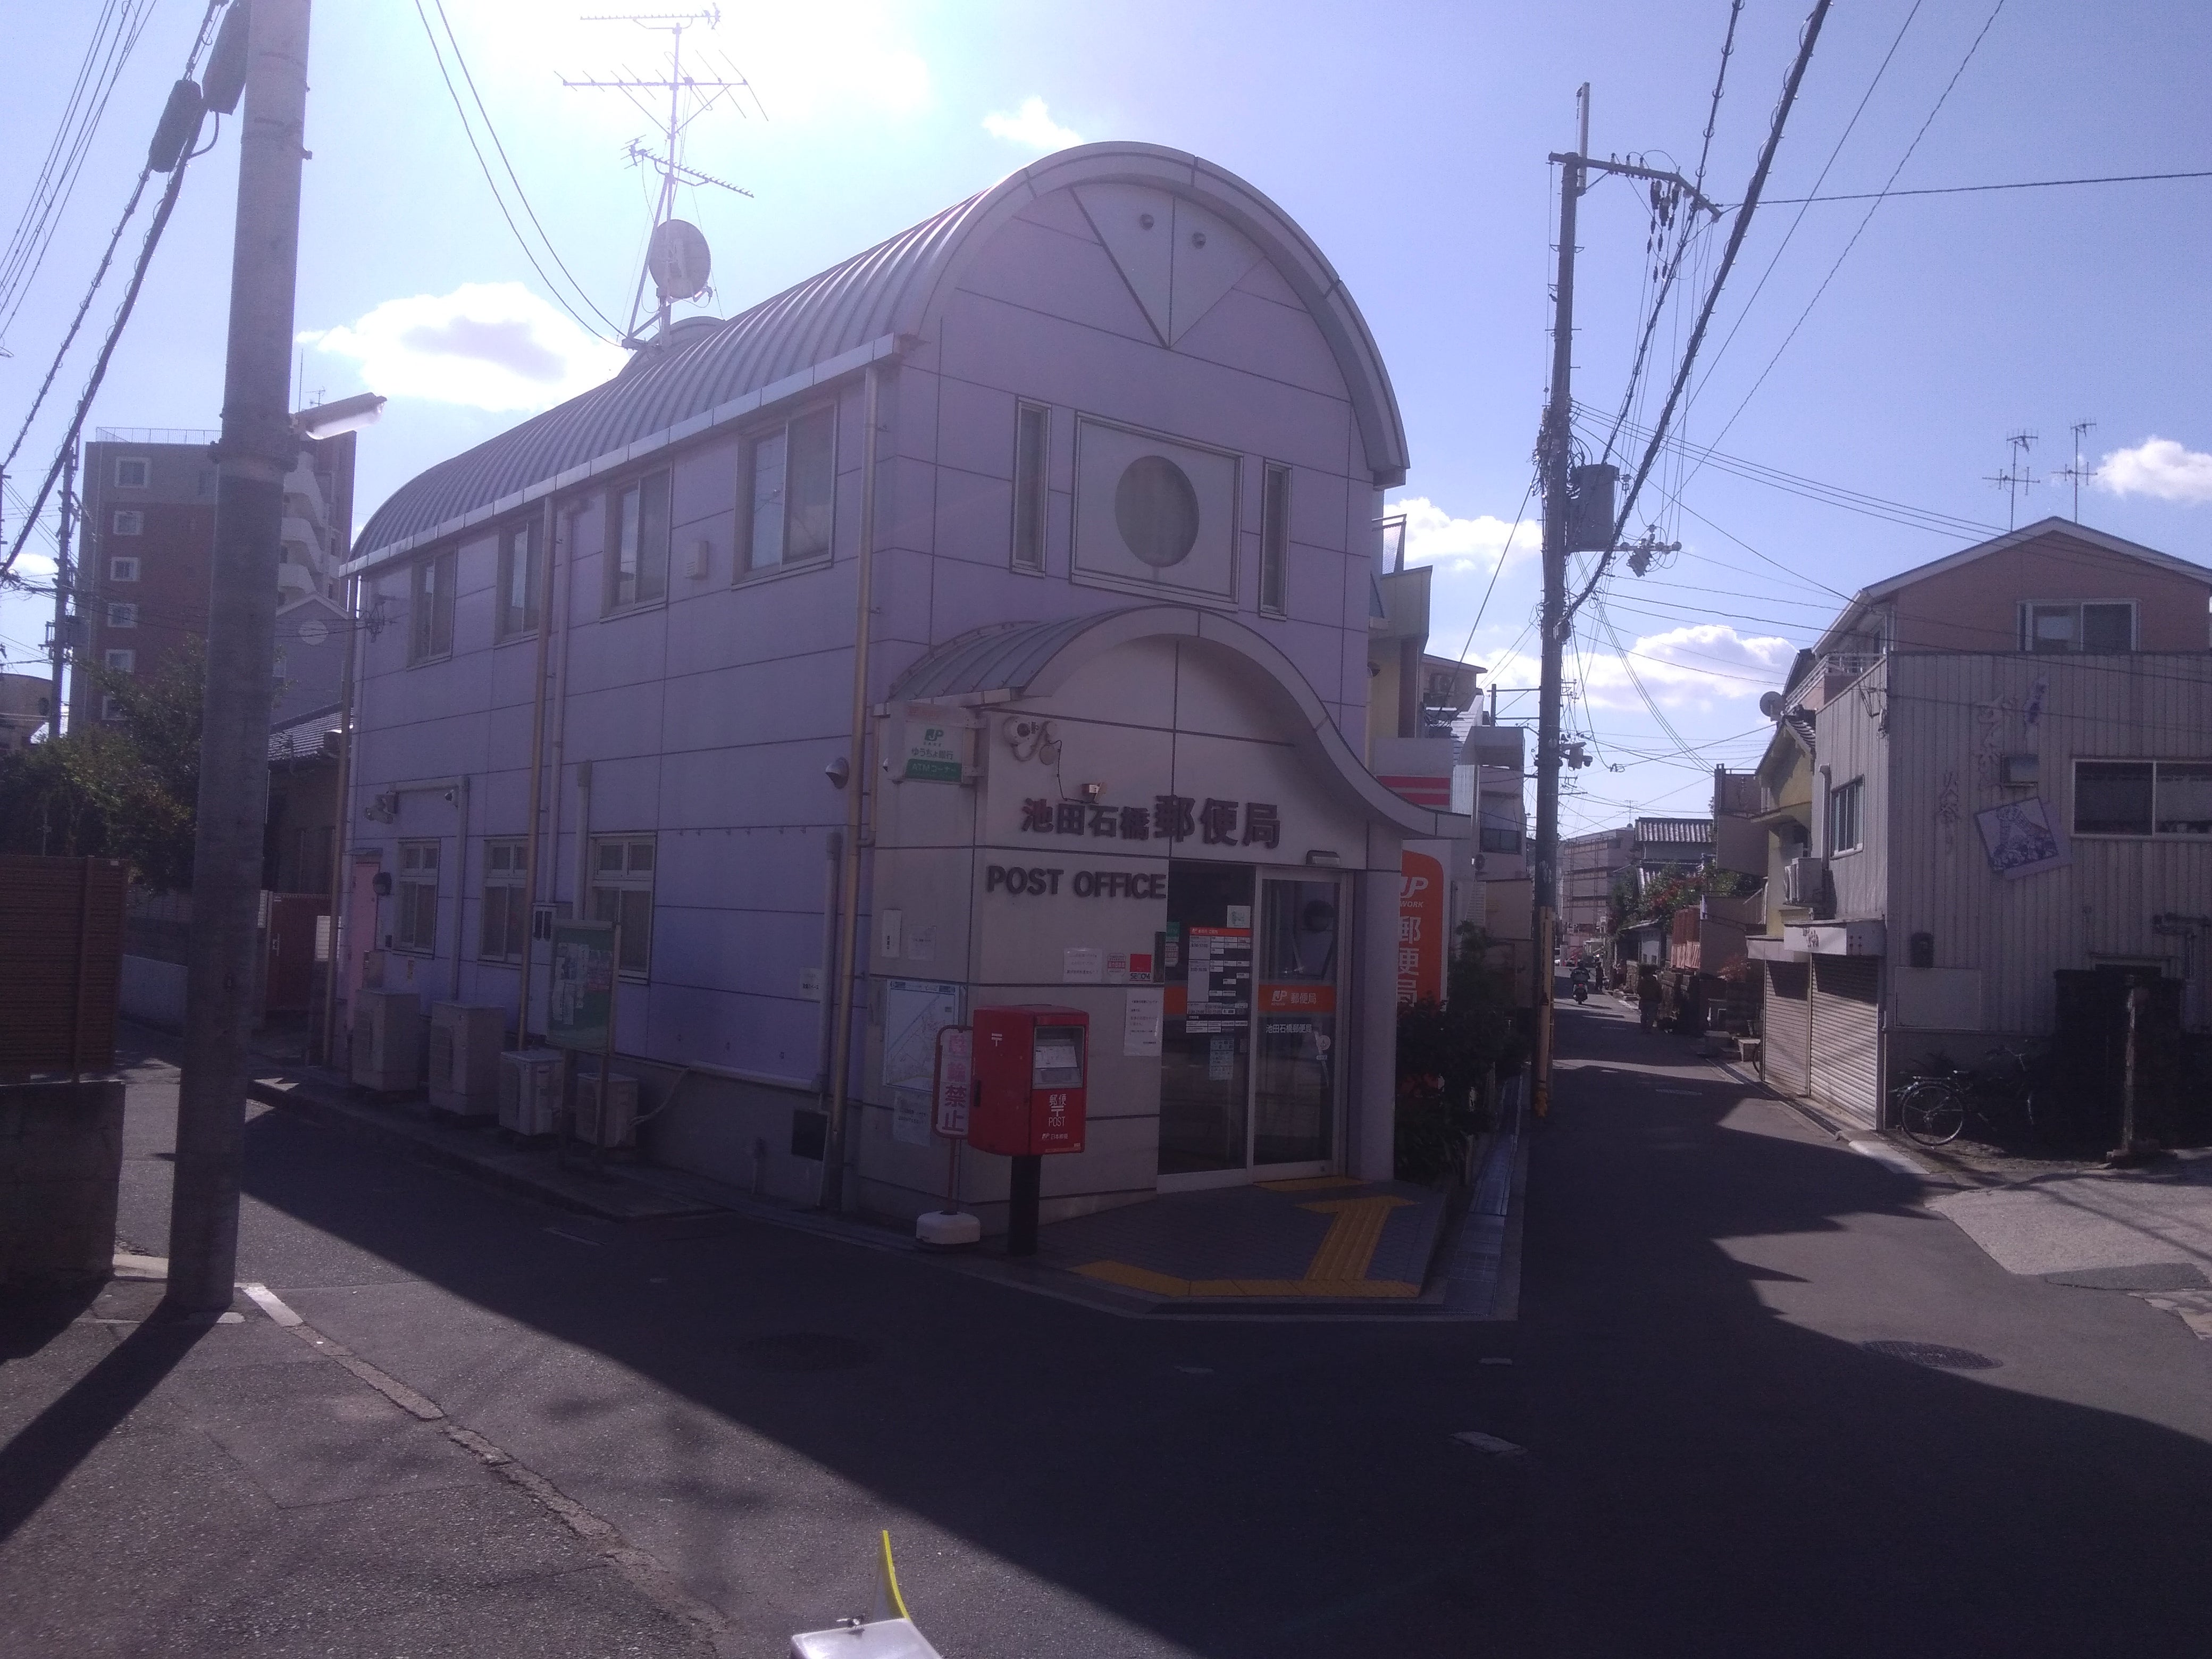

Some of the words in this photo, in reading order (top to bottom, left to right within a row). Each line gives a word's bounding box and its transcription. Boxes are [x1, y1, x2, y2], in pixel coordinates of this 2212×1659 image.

[924, 728, 944, 741] JP
[911, 747, 954, 760] ゆうちょ銀行
[911, 763, 957, 773] ATMコーナー
[1021, 794, 1281, 849] 池田石橋郵便局
[986, 866, 1064, 896] POST
[1073, 870, 1167, 899] OFFICE
[1400, 900, 1424, 908] WORK
[1271, 990, 1287, 1002] JP
[1291, 992, 1317, 1004] 郵便局
[1266, 1023, 1312, 1034] 池田石橋郵便局
[1049, 1093, 1067, 1107] 郵便
[1048, 1116, 1066, 1127] POST
